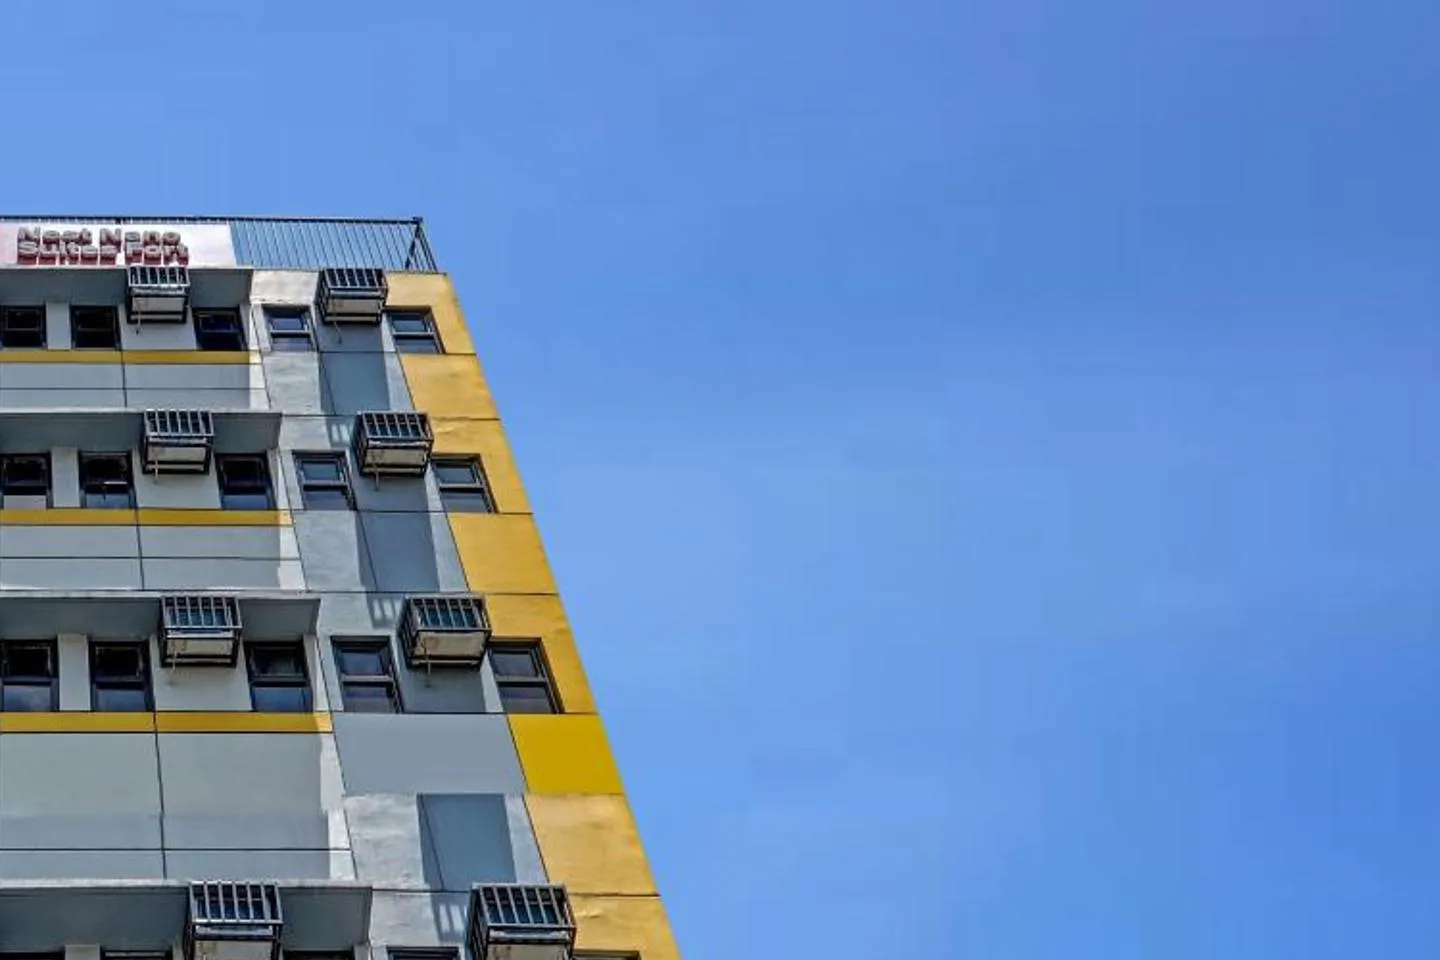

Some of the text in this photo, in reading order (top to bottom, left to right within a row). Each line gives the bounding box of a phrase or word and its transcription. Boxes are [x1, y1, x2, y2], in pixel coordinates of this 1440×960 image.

[99, 228, 181, 244] Nano
[17, 241, 189, 259] Suites Fort
